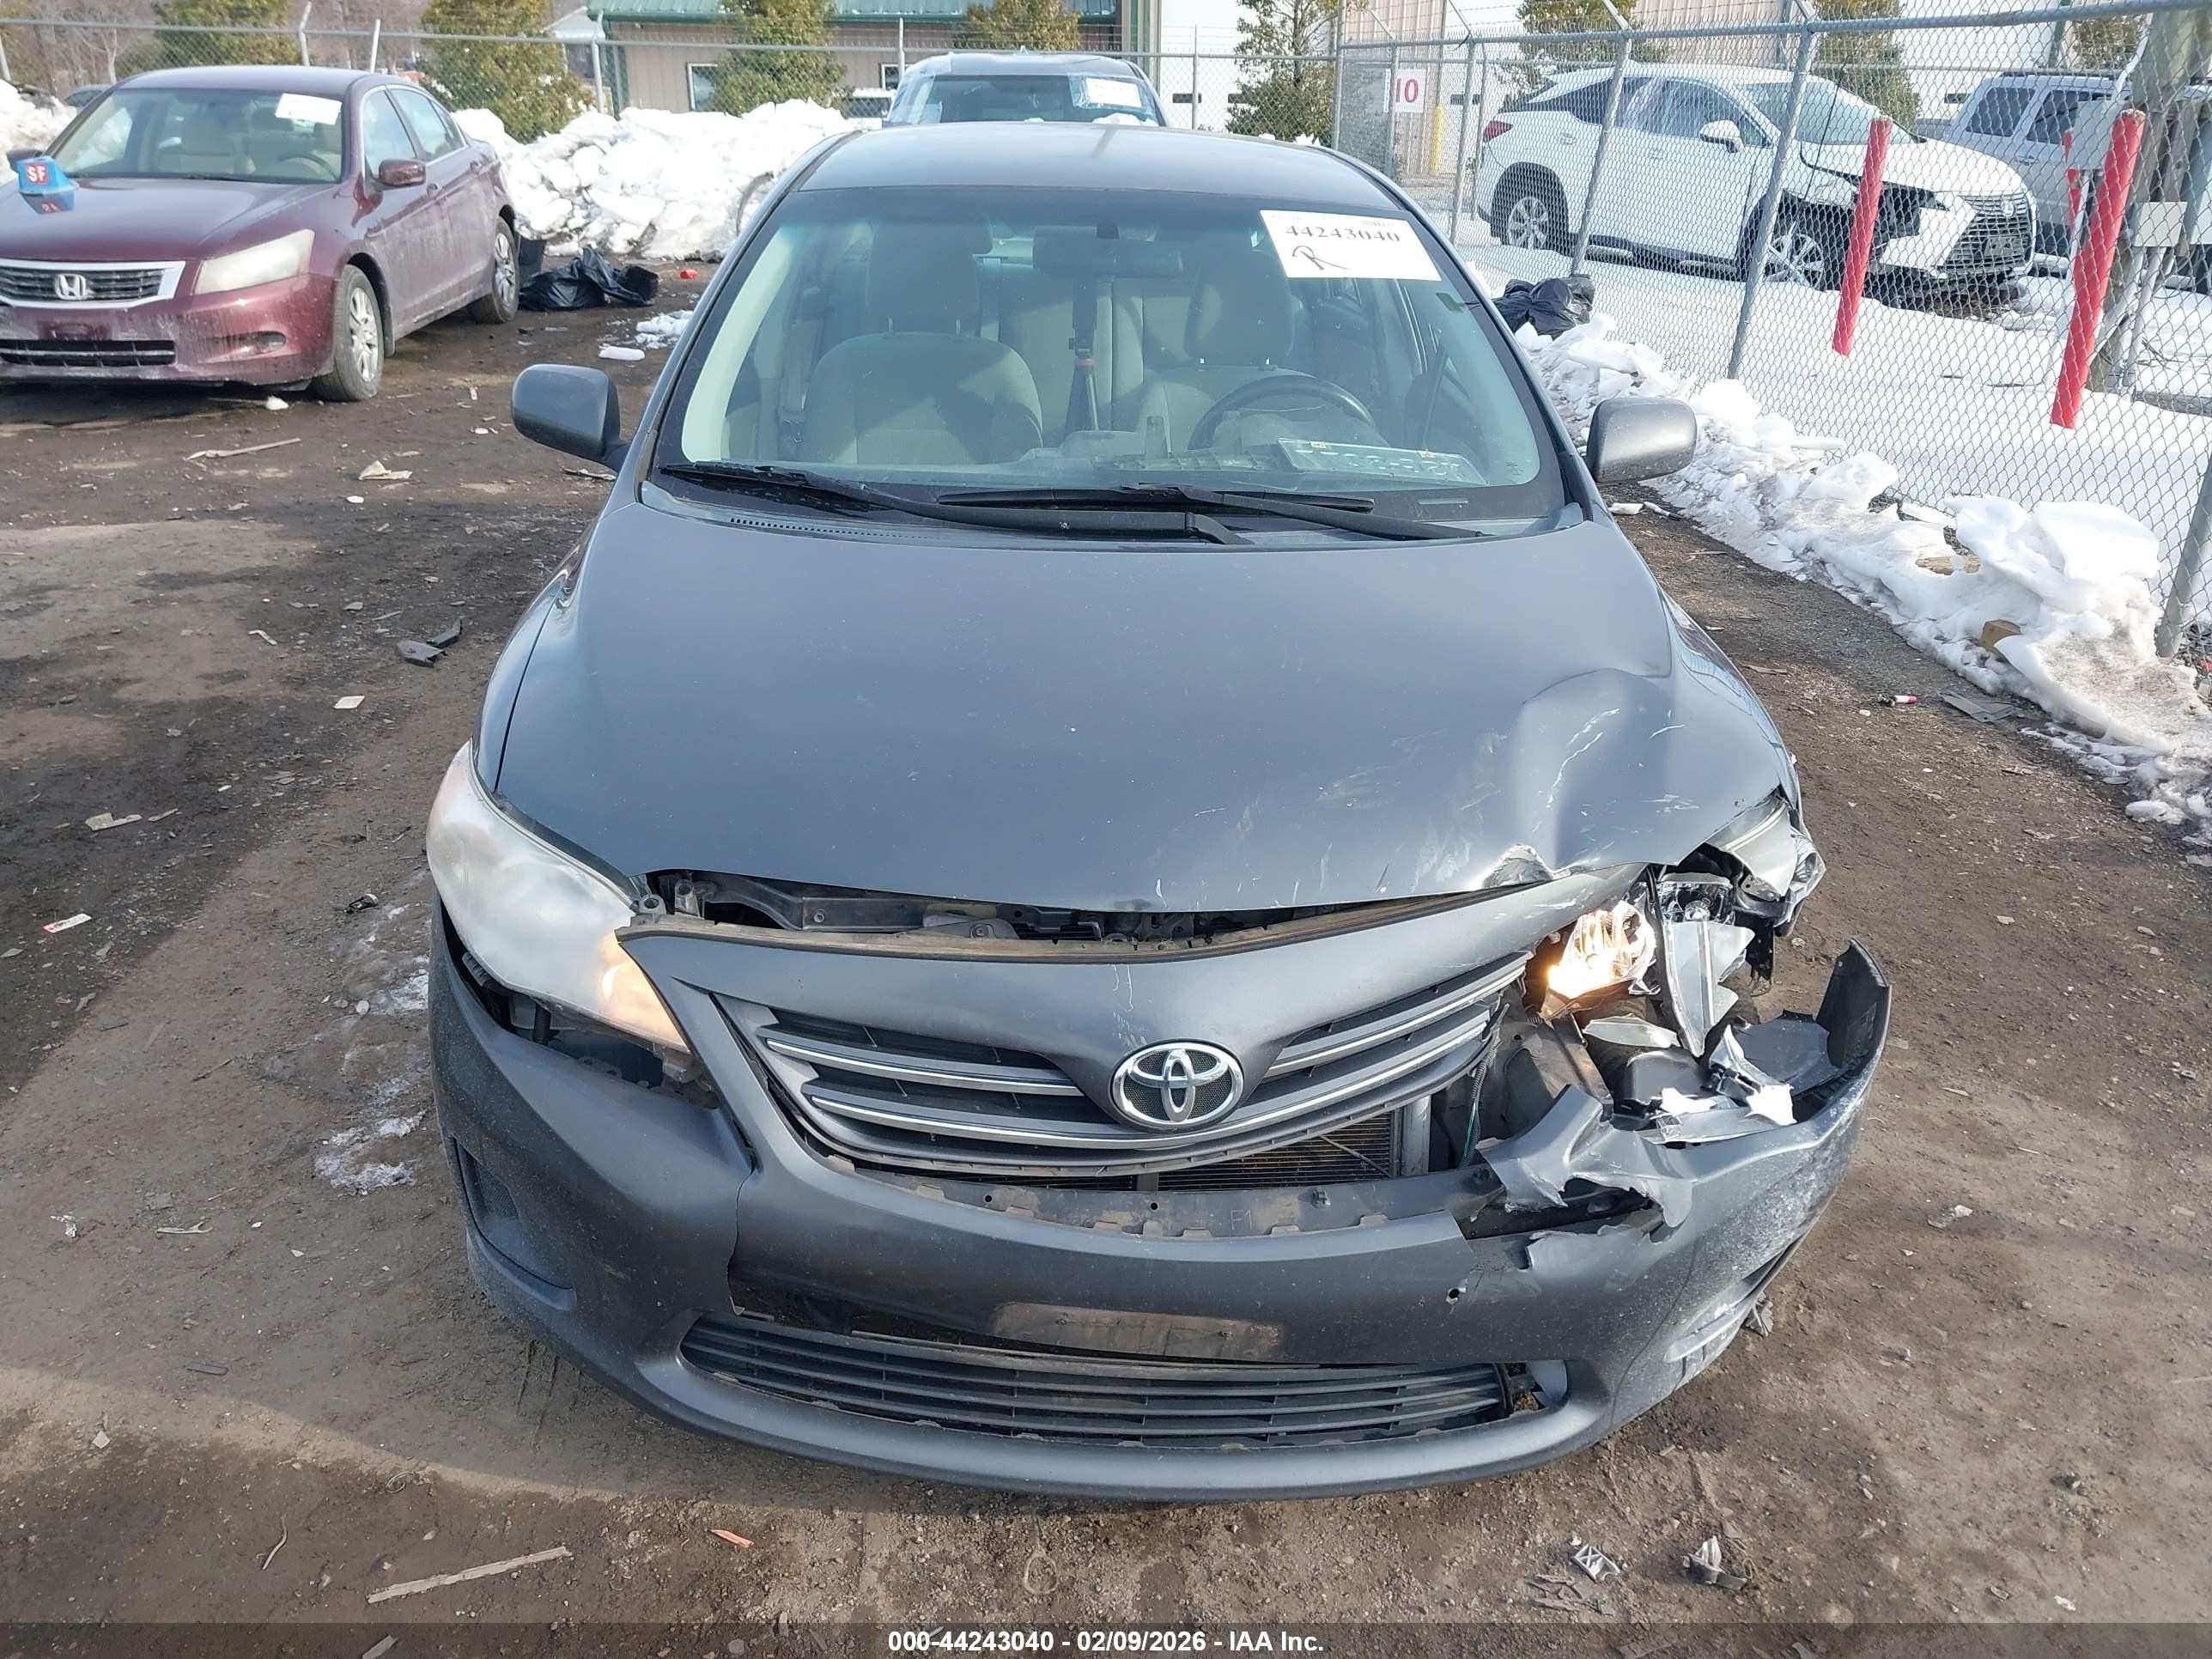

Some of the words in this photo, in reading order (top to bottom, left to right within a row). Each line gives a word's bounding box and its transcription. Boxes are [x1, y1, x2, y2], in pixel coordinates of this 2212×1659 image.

[1395, 78, 1419, 103] 10
[27, 165, 46, 183] SF
[1286, 225, 1401, 242] 44243040
